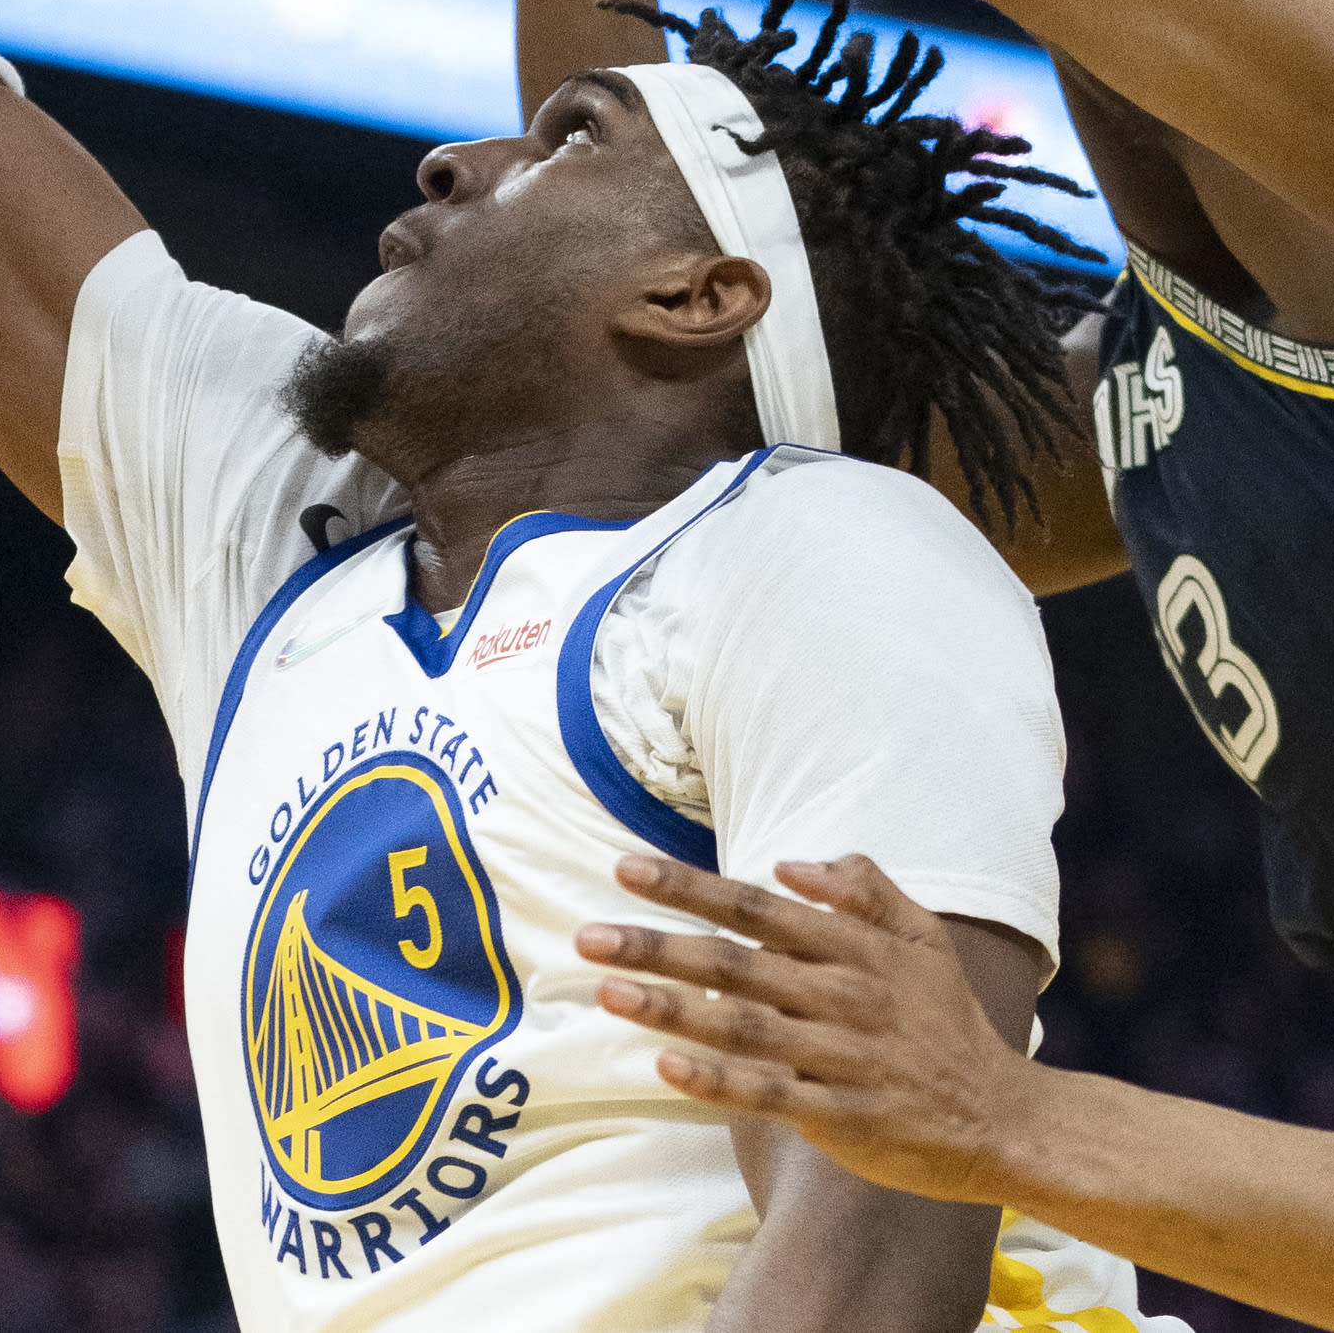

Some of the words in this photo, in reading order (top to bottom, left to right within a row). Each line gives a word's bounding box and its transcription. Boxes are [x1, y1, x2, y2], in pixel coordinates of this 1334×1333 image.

[466, 619, 552, 669] Rakuten
[248, 707, 398, 887] GOLDEN
[414, 706, 498, 815] STATE
[388, 846, 443, 969] 5
[260, 1057, 531, 1280] WARRIORS
